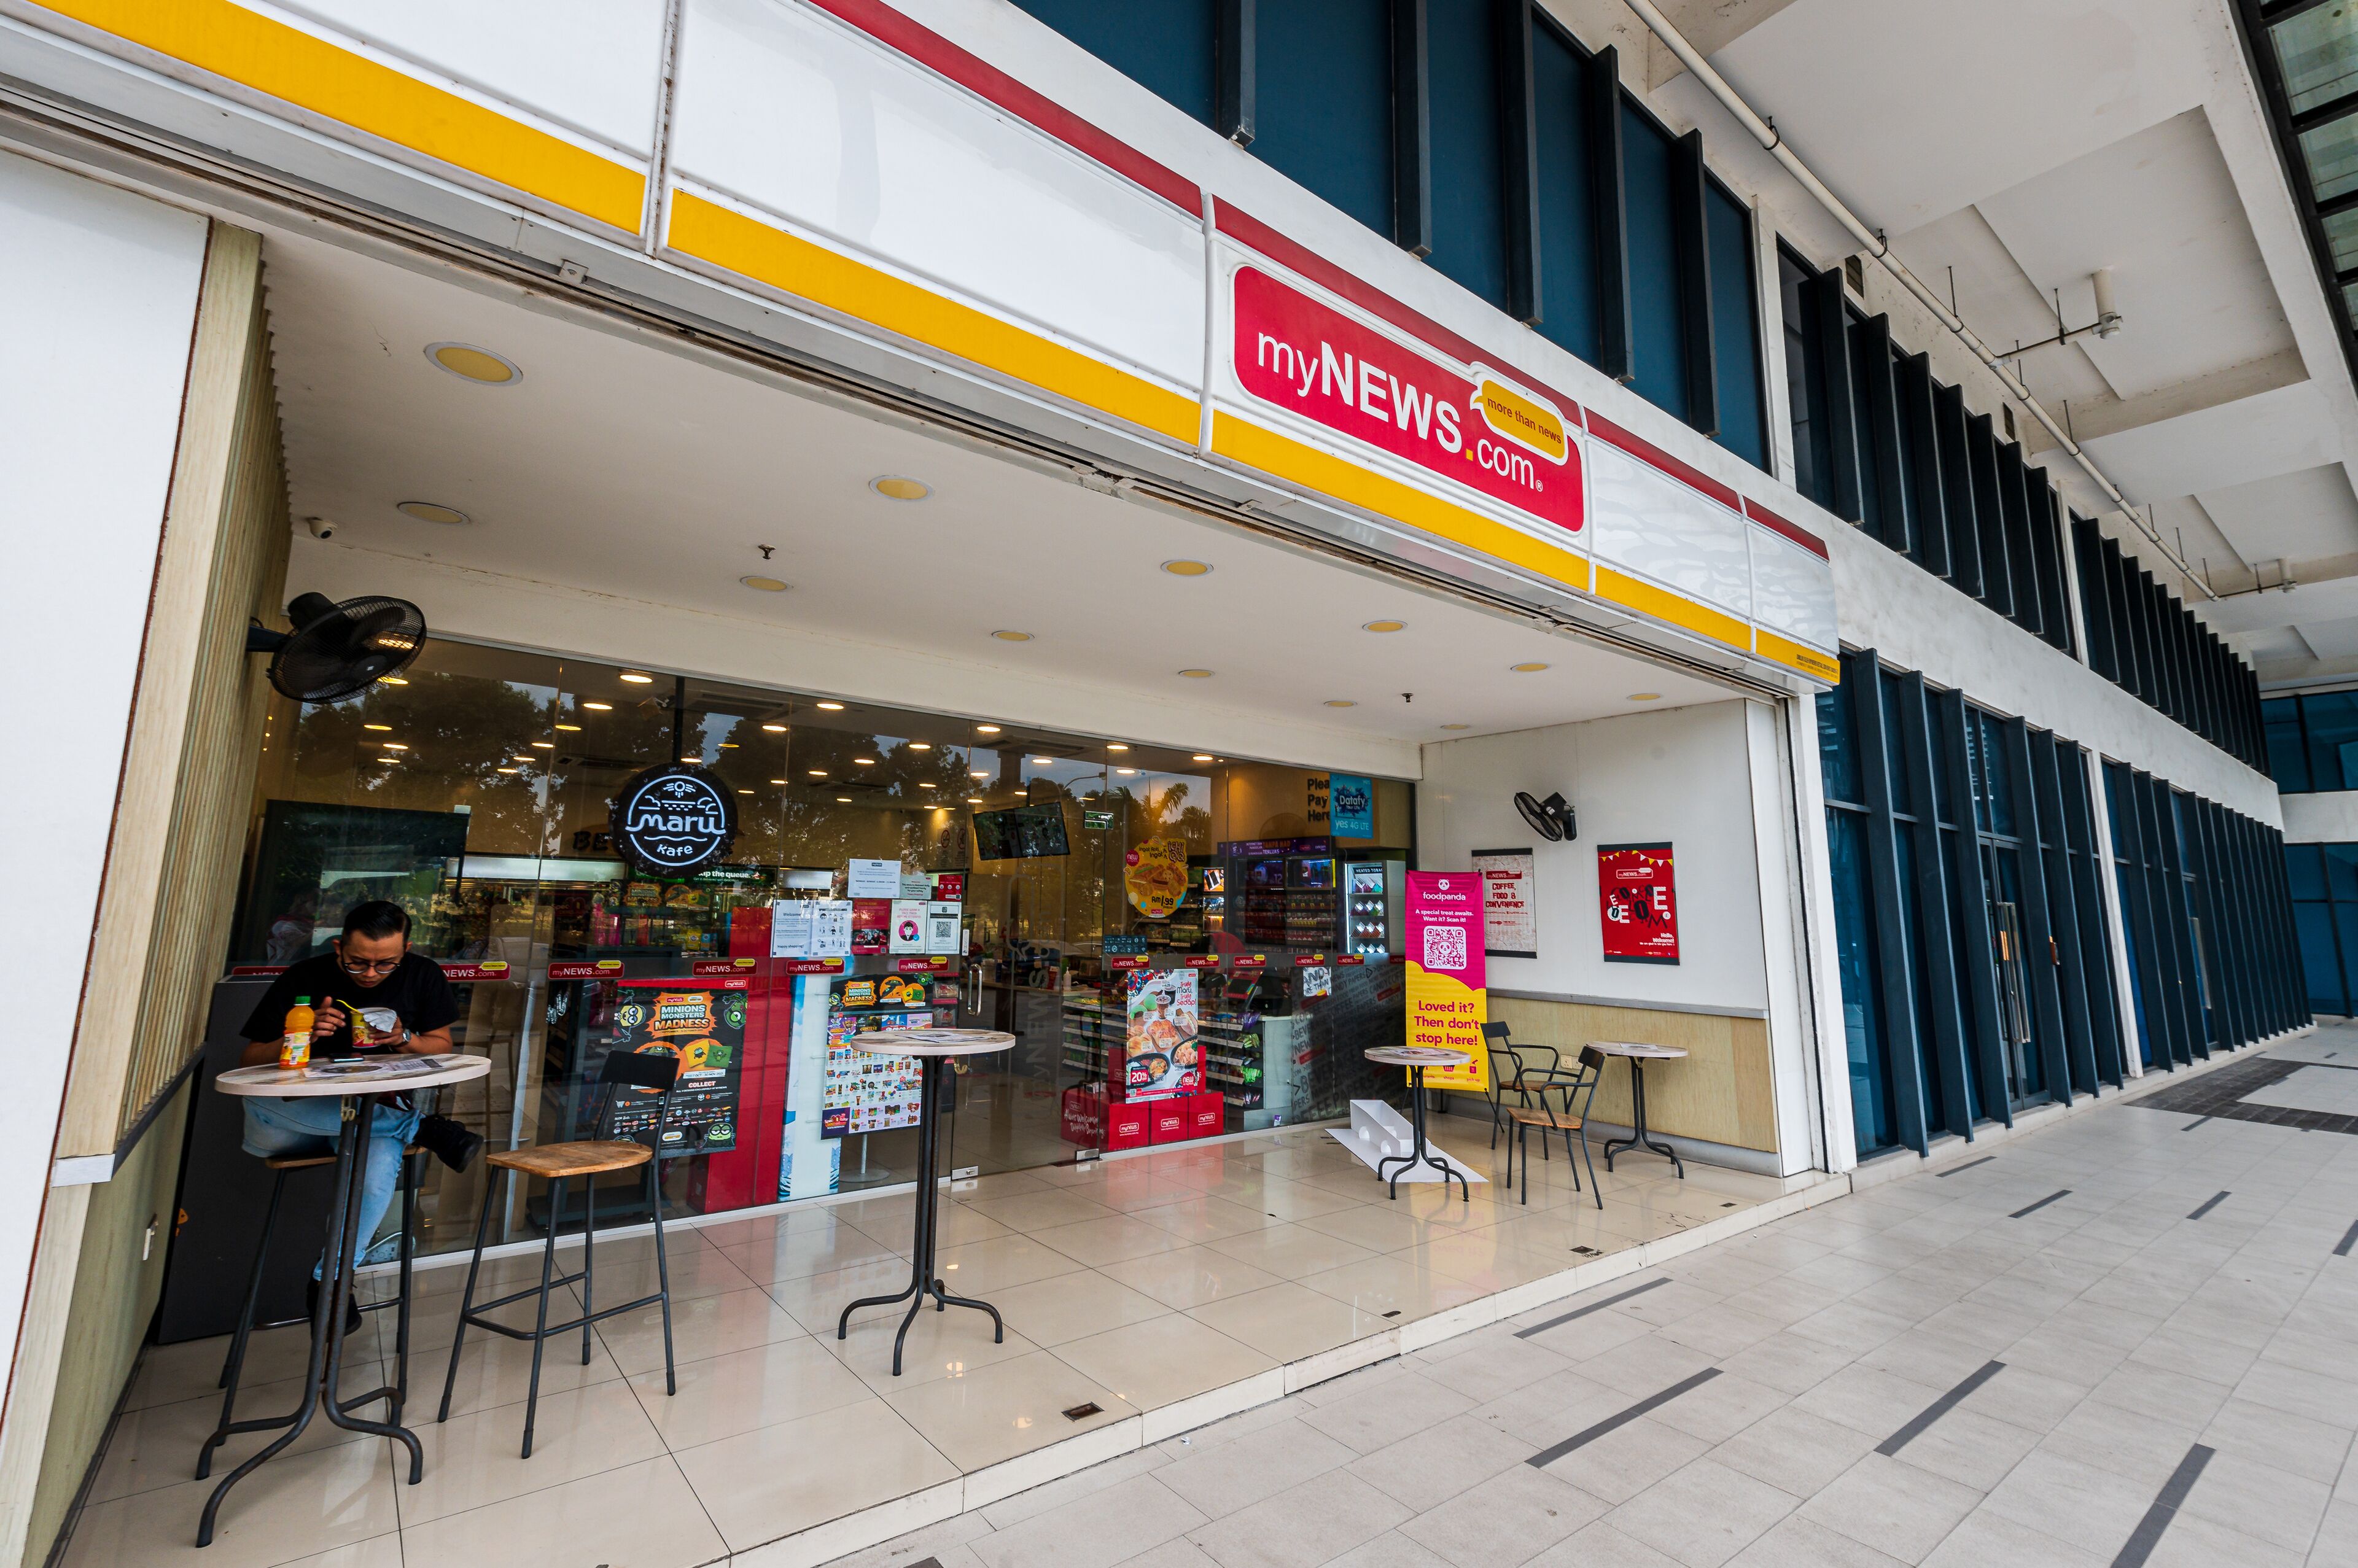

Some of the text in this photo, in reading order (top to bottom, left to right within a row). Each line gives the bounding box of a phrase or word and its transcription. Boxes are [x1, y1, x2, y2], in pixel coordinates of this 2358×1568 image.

[1487, 398, 1562, 444] more than news
[1307, 794, 1328, 809] Pay
[1339, 795, 1364, 807] Datafy
[1335, 820, 1348, 830] yes
[1423, 891, 1466, 902] foodpanda
[789, 964, 834, 972] myNEWS.com
[900, 962, 940, 971] myNEWS.com
[553, 968, 610, 977] myNEWS.com
[661, 1004, 706, 1014] MINIONS
[1418, 999, 1474, 1013] Loved it?
[655, 1019, 710, 1030] MADNESS
[1414, 1015, 1444, 1028] Then
[1415, 1031, 1478, 1047] stop here!
